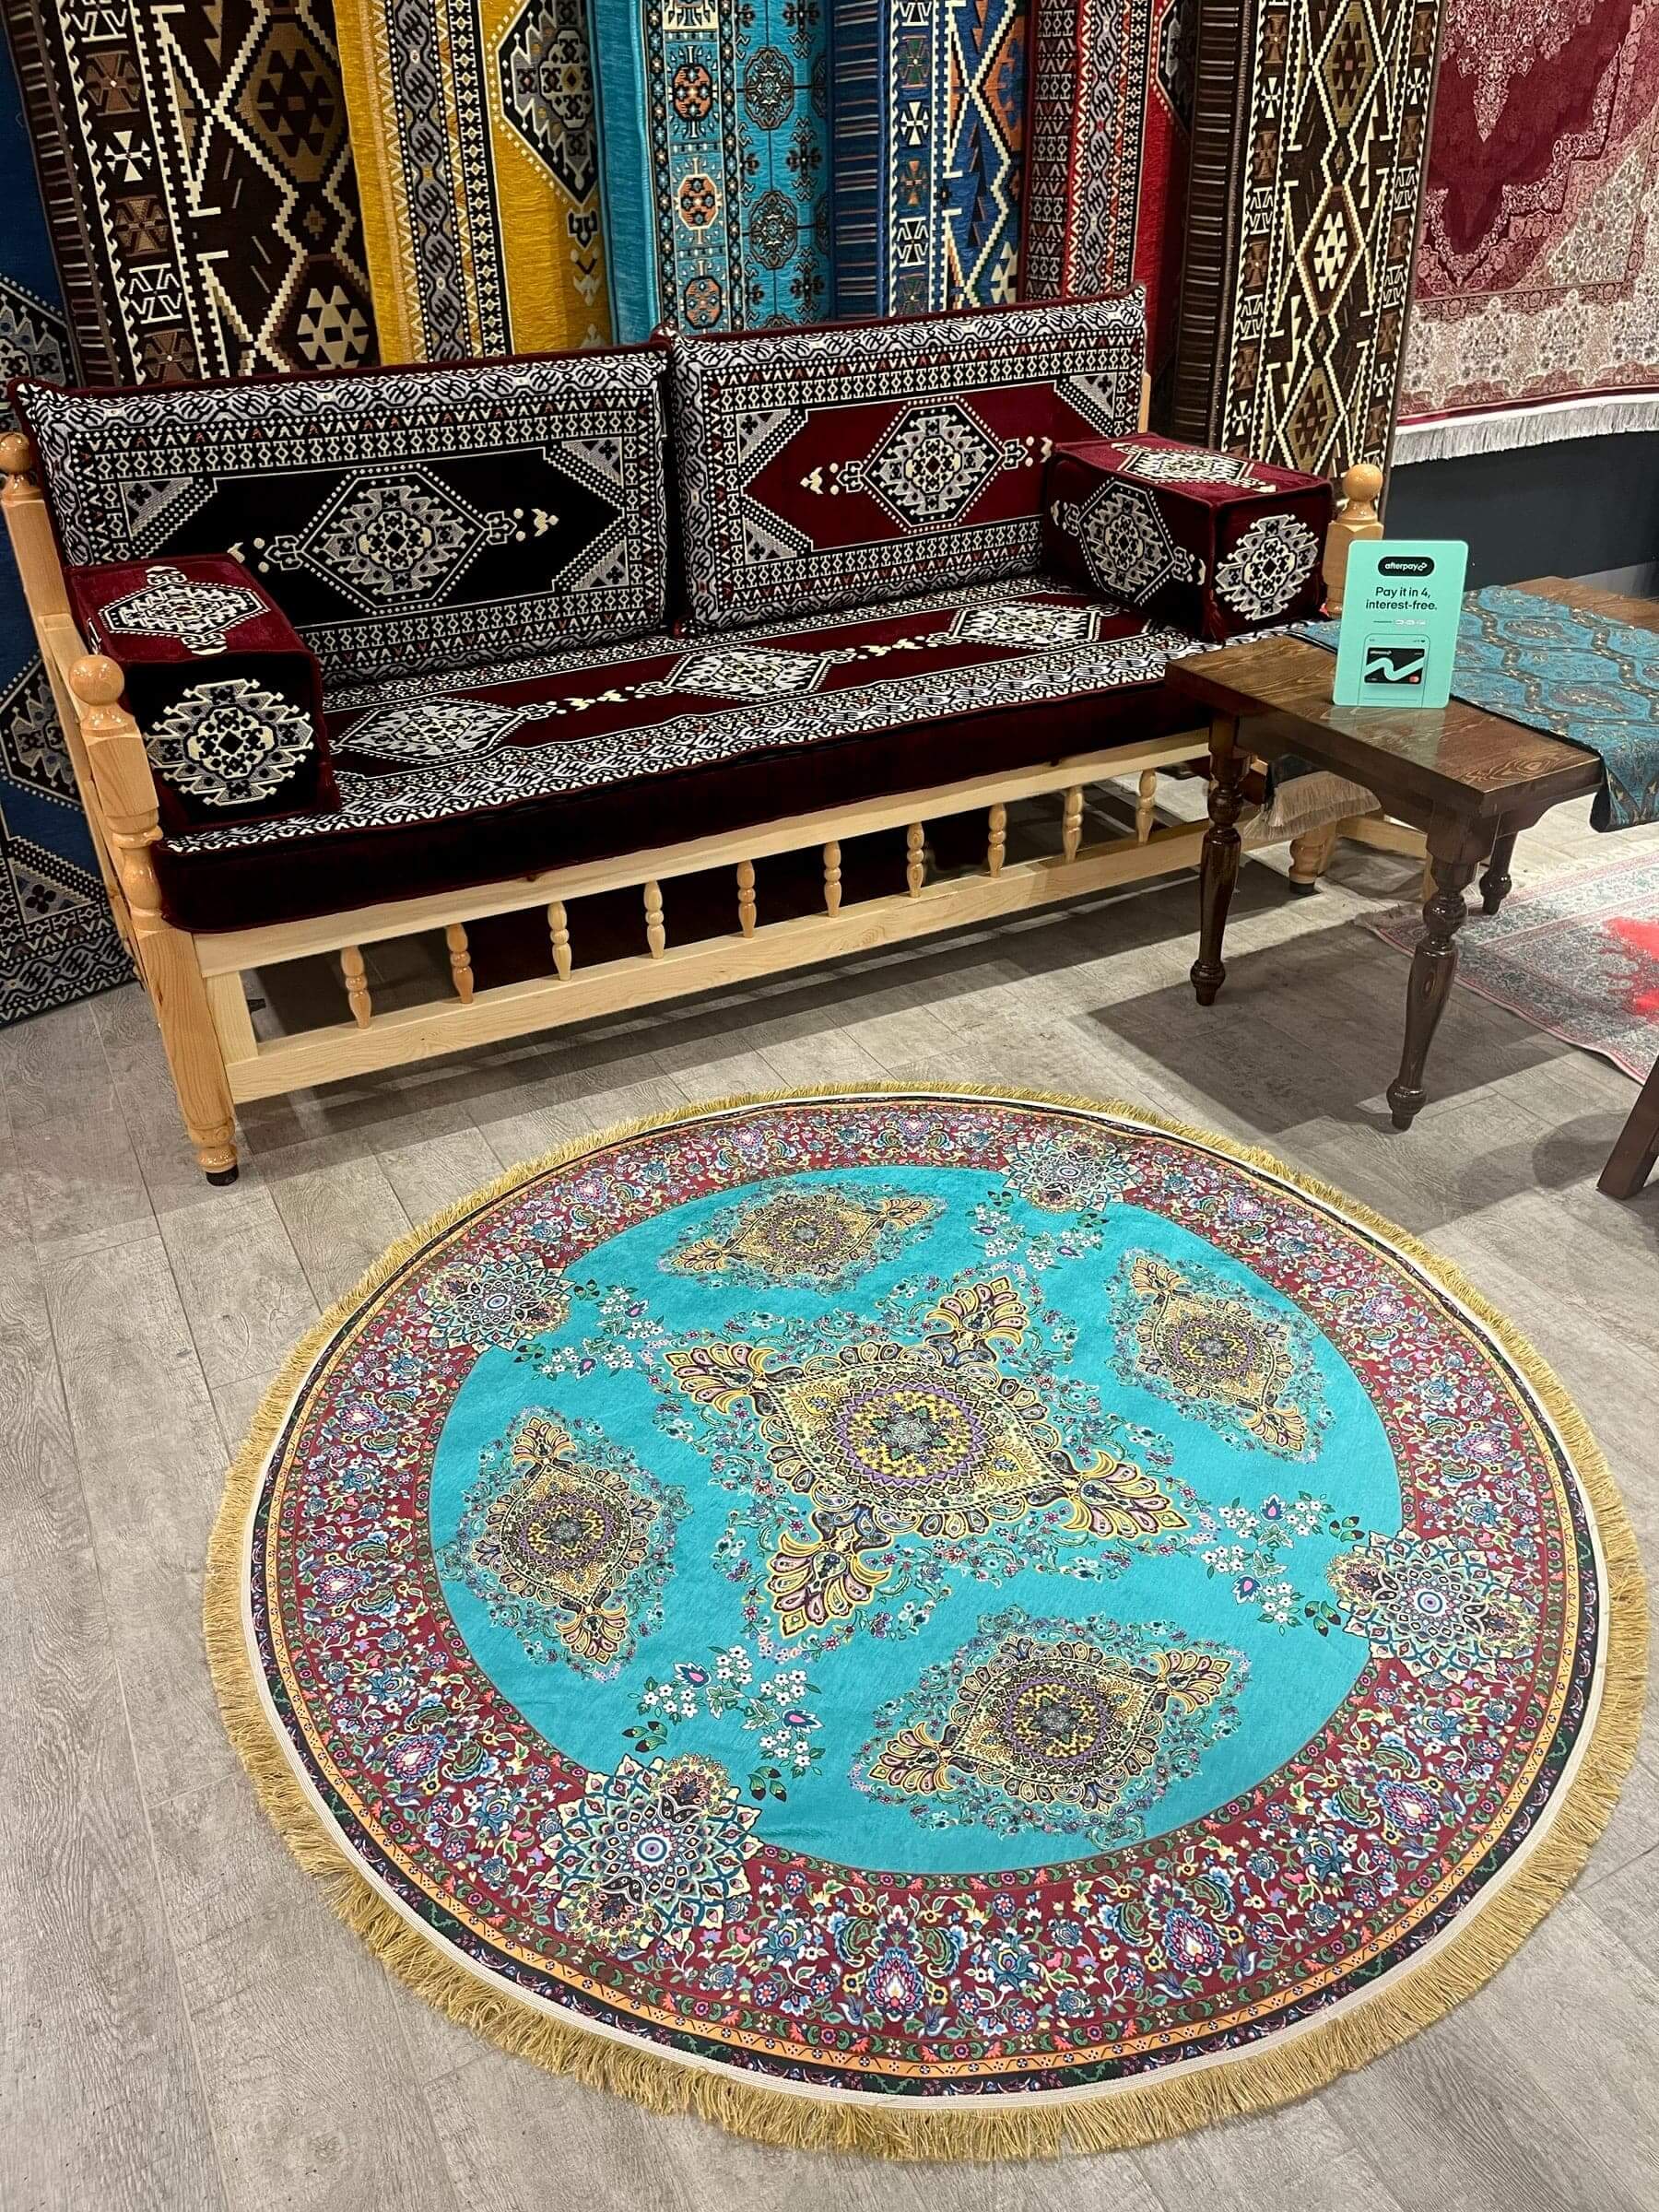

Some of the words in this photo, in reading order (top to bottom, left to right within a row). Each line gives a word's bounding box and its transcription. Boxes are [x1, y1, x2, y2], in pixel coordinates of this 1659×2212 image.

[1384, 561, 1418, 571] afterpay
[1375, 586, 1397, 599] Pay
[1399, 586, 1406, 597] it
[1408, 586, 1418, 597] in
[1420, 587, 1431, 598] 4,
[1365, 598, 1438, 610] interest-free.
